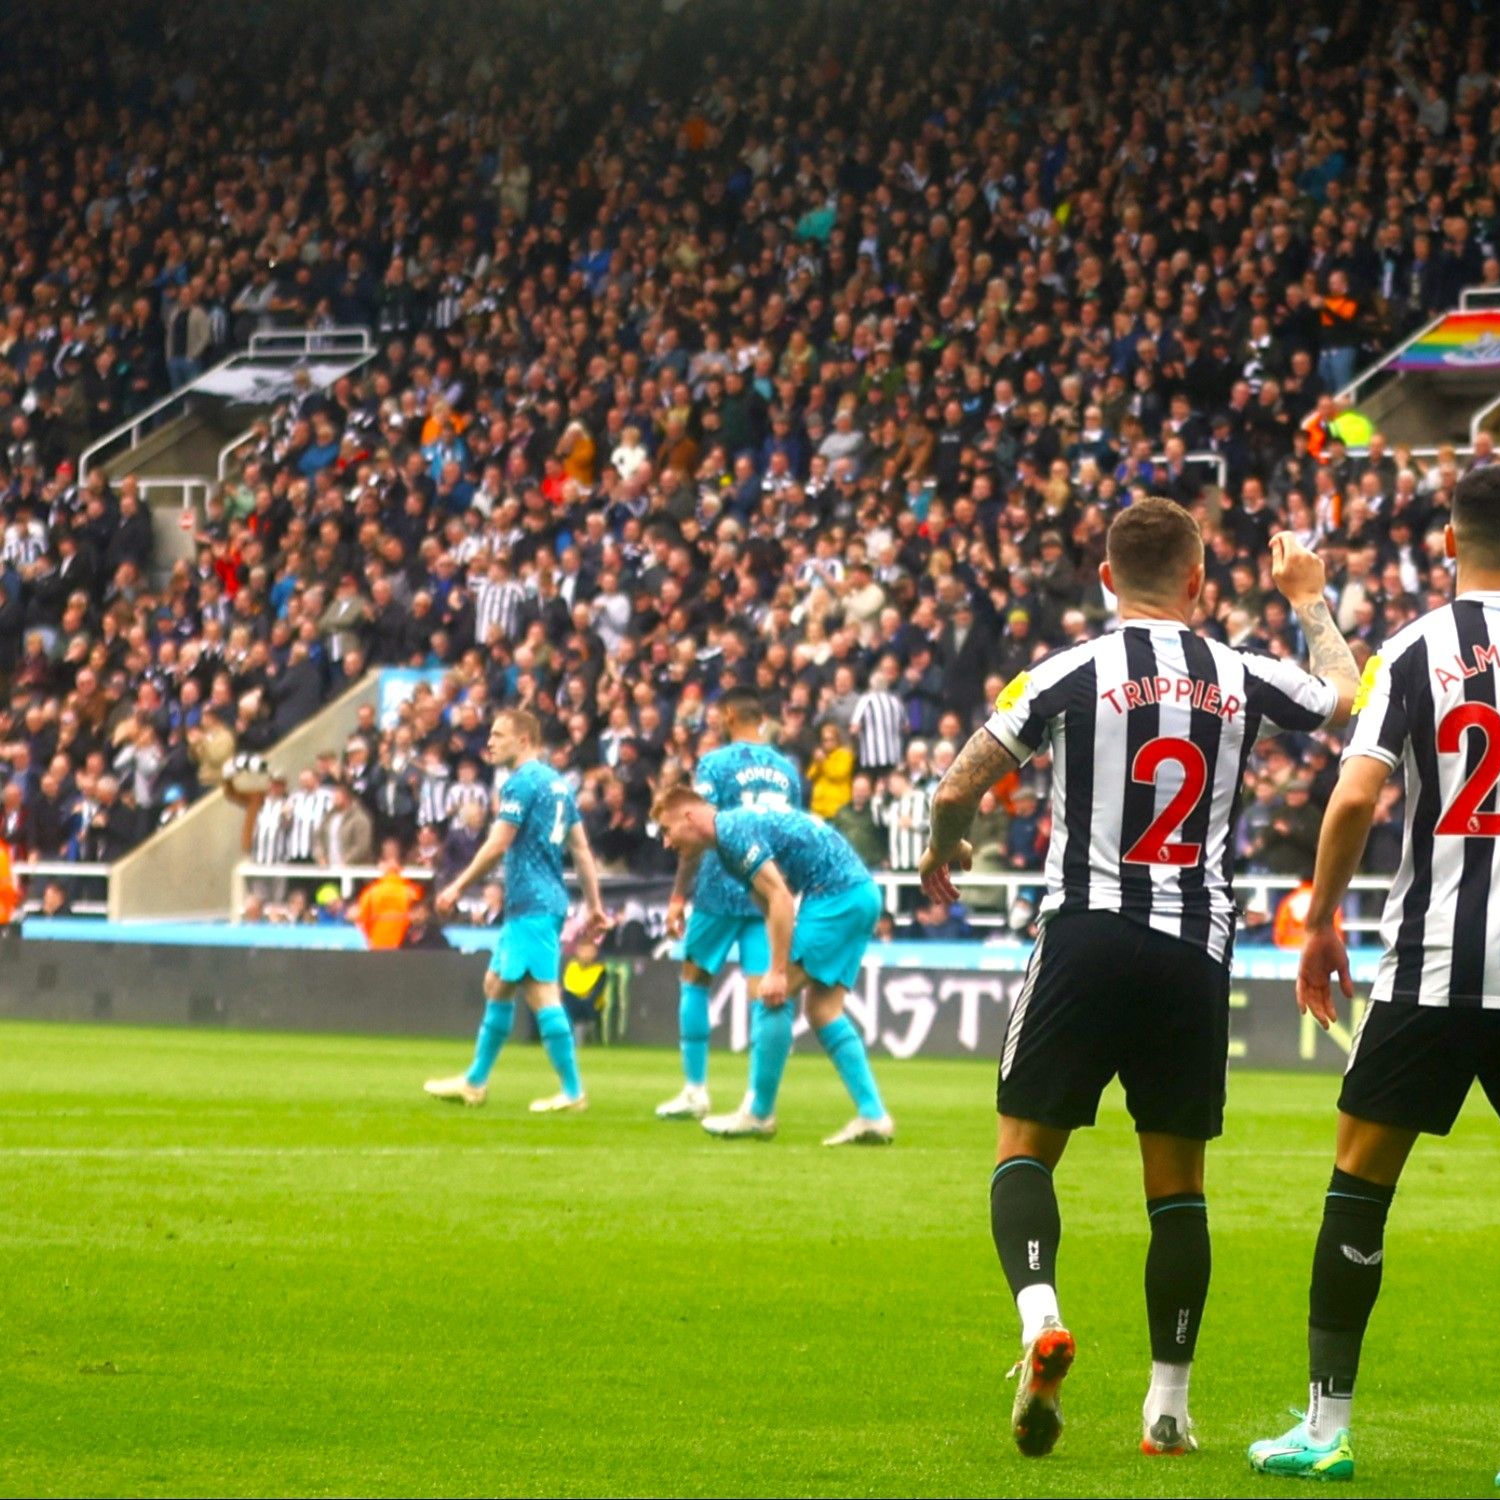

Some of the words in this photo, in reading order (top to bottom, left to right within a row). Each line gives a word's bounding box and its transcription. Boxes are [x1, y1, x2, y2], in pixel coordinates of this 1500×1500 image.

[1100, 676, 1241, 723] TRIPPIER
[735, 766, 789, 789] ROMERO
[1122, 737, 1208, 868] 2
